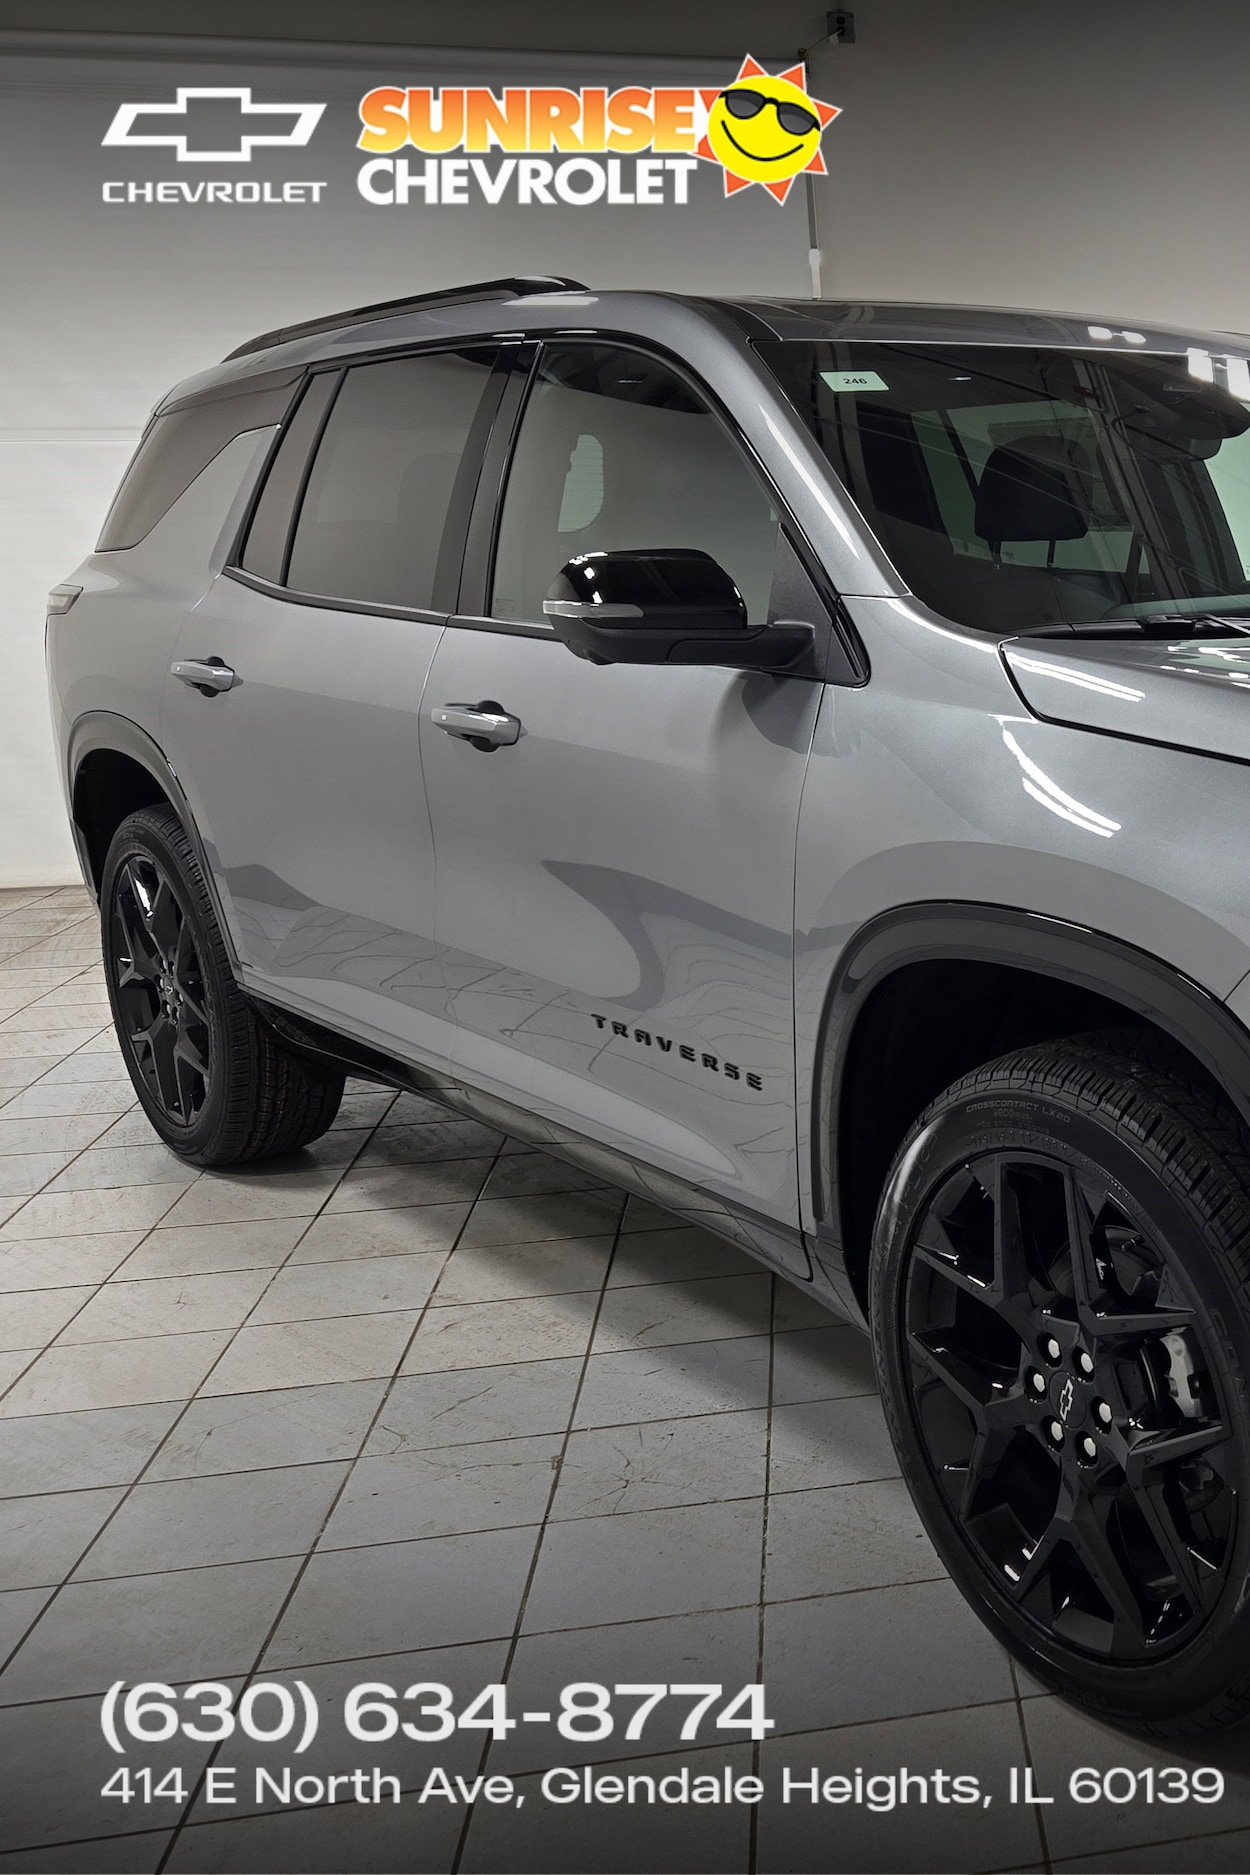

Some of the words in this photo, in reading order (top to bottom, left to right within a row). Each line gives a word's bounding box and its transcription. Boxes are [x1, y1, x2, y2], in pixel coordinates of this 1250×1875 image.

[590, 1013, 763, 1092] TRAVERSE
[966, 1099, 1039, 1113] CROSSCONTACT
[1042, 1106, 1071, 1123] LX20
